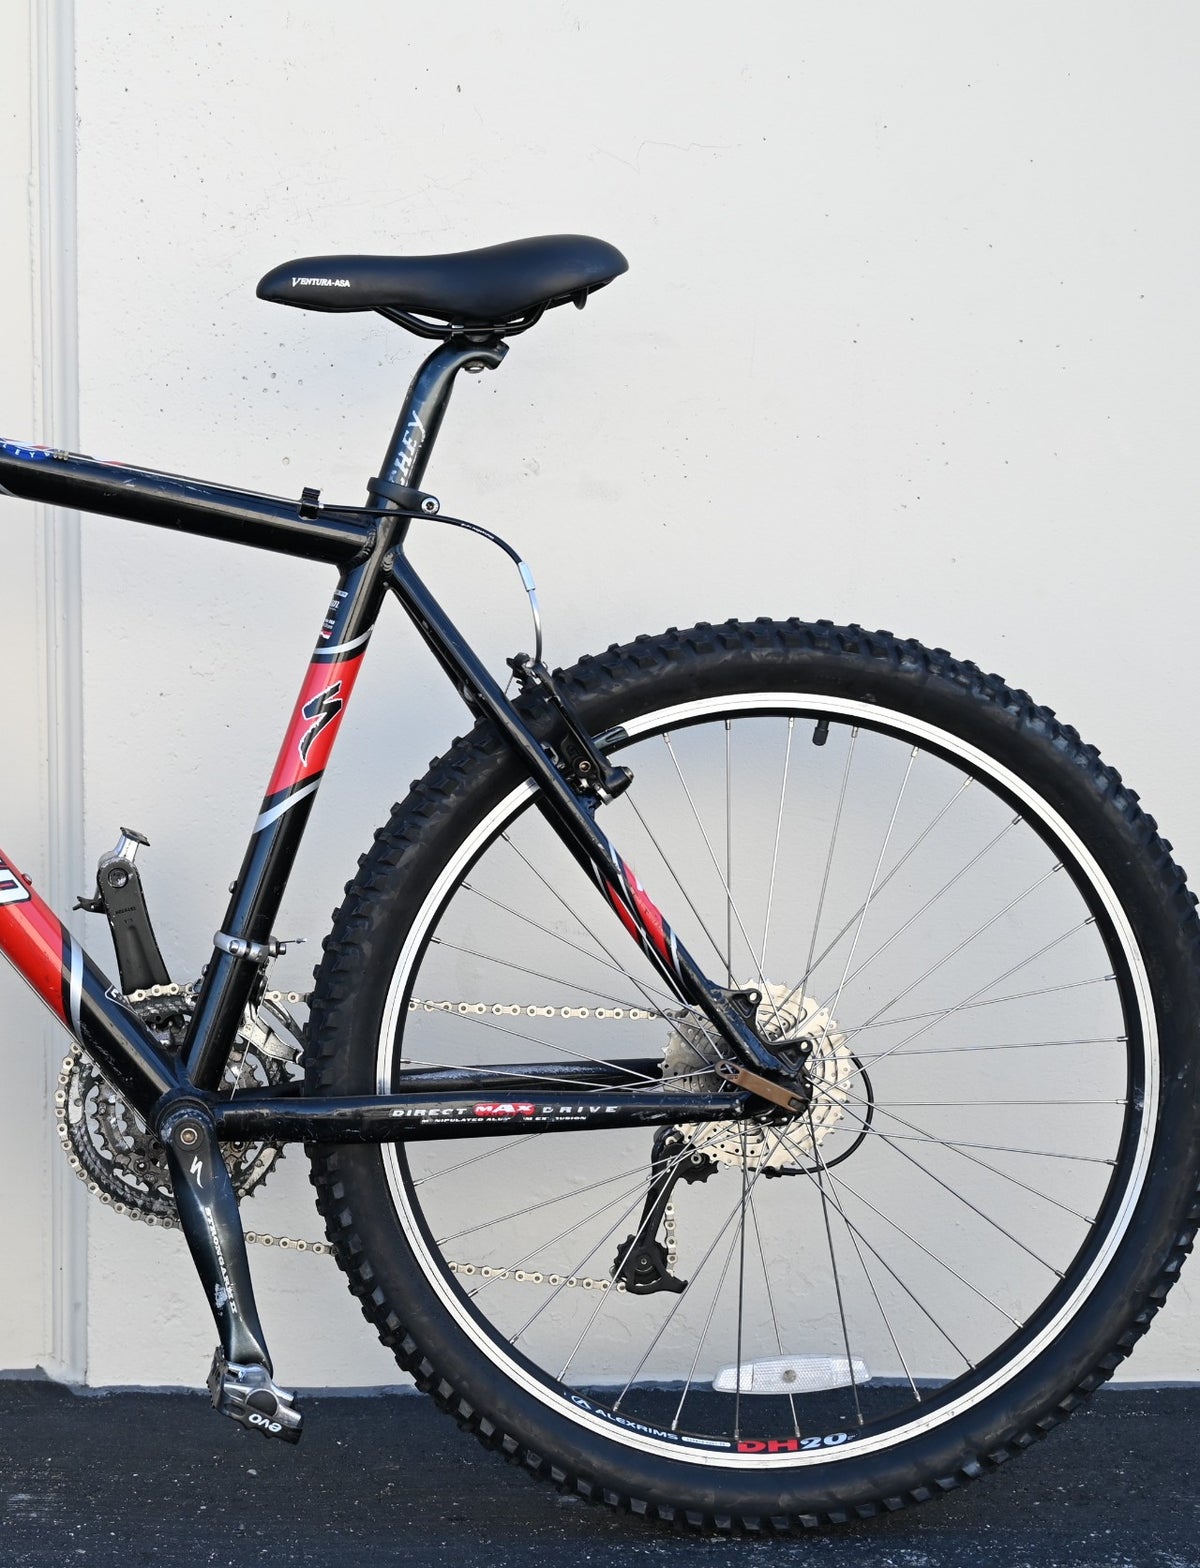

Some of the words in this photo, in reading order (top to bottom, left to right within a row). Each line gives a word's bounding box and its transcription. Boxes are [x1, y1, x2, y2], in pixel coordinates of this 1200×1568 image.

[392, 1108, 467, 1117] DIRECT
[474, 1104, 535, 1113] MAX
[248, 1413, 282, 1434] evo
[595, 1408, 678, 1441] ALEXRIMS
